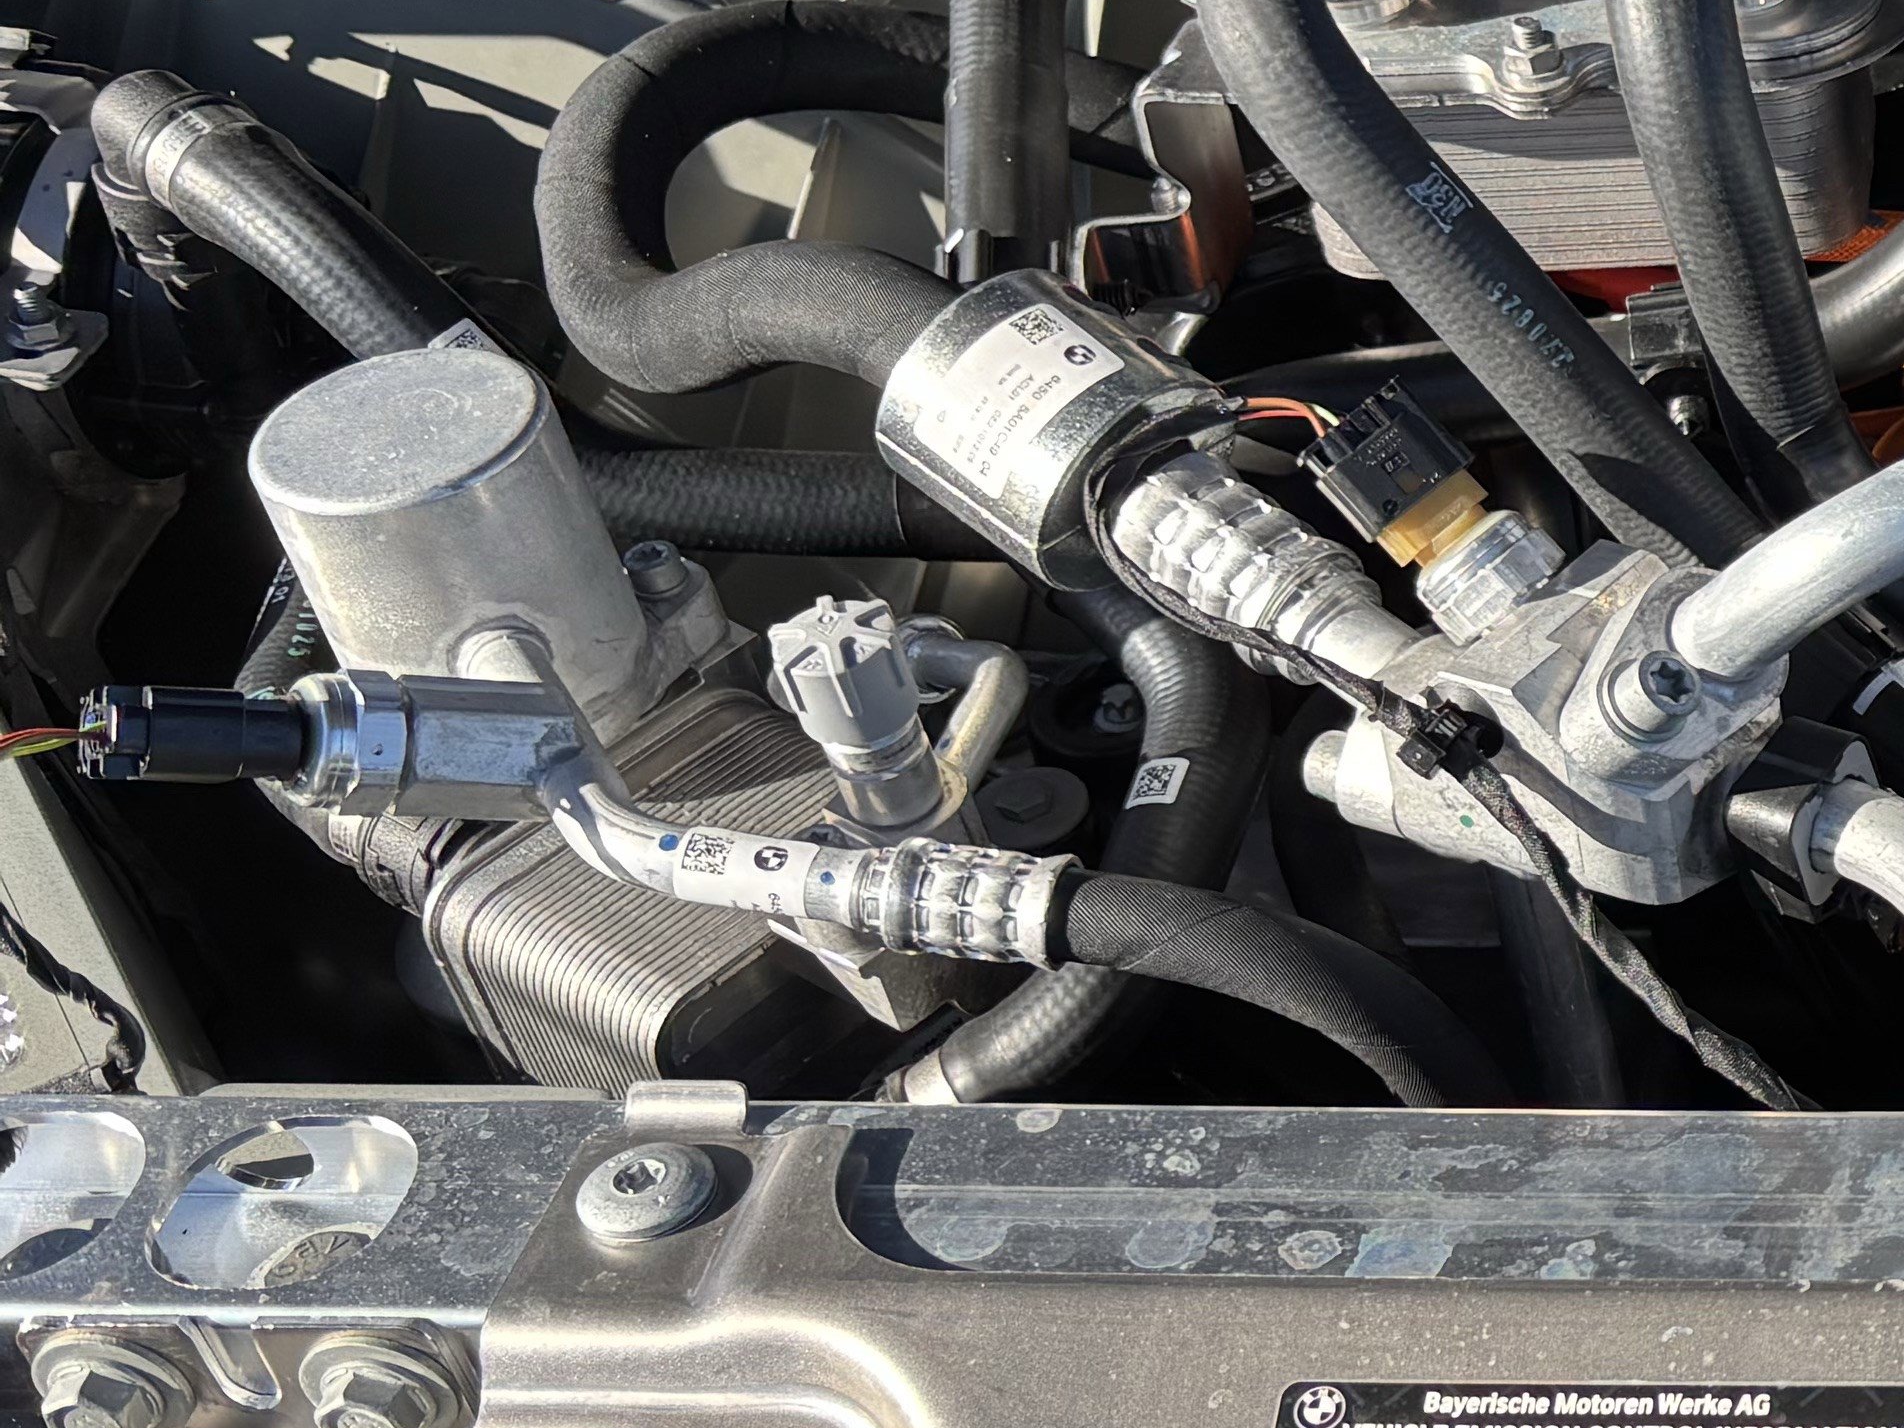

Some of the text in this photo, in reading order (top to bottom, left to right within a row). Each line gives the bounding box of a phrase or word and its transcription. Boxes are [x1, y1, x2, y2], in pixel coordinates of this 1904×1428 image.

[1423, 1391, 1770, 1418] Bayerische Motoren Werke AG
